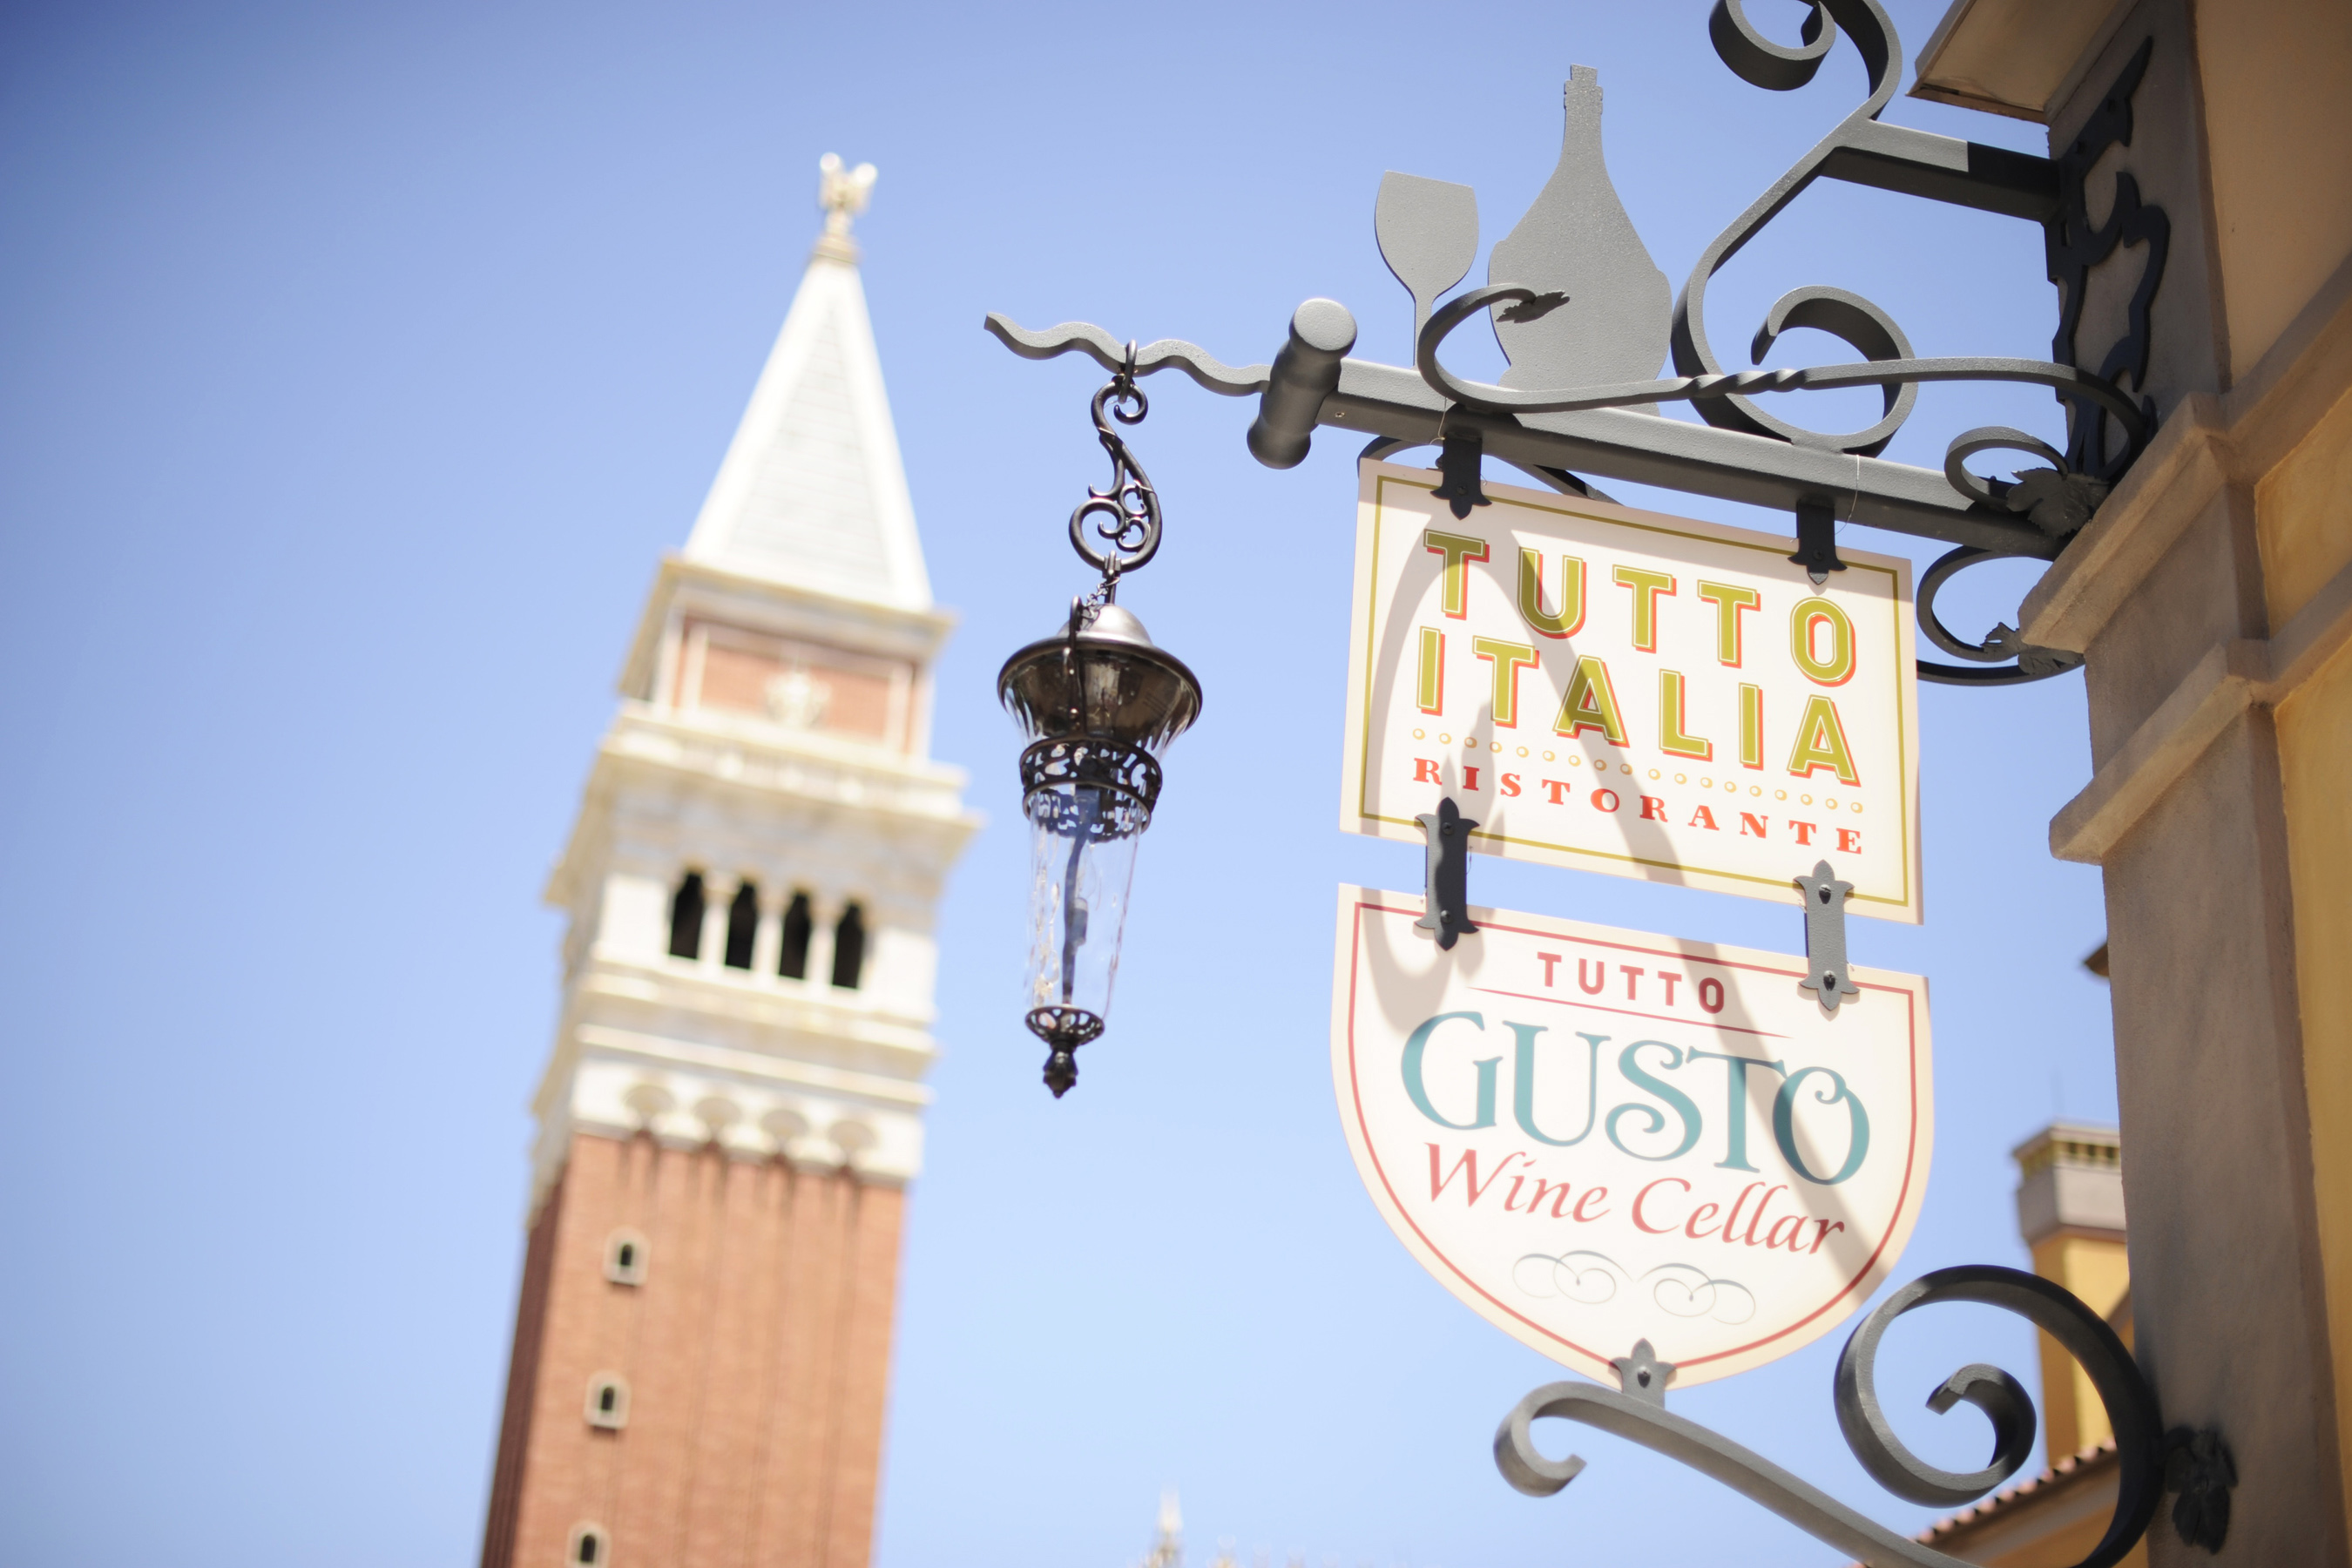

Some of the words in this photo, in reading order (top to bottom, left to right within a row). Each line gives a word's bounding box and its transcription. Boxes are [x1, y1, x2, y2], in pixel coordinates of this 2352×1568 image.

[1424, 529, 1855, 686] TUTTO
[1416, 625, 1861, 787] ITALIA
[1413, 758, 1862, 854] RISTORANTE
[1538, 951, 1725, 1015] TUTTO
[1401, 1010, 1870, 1186] GUSTO
[1423, 1142, 1611, 1222] Wine
[1631, 1177, 1845, 1254] Cellar
